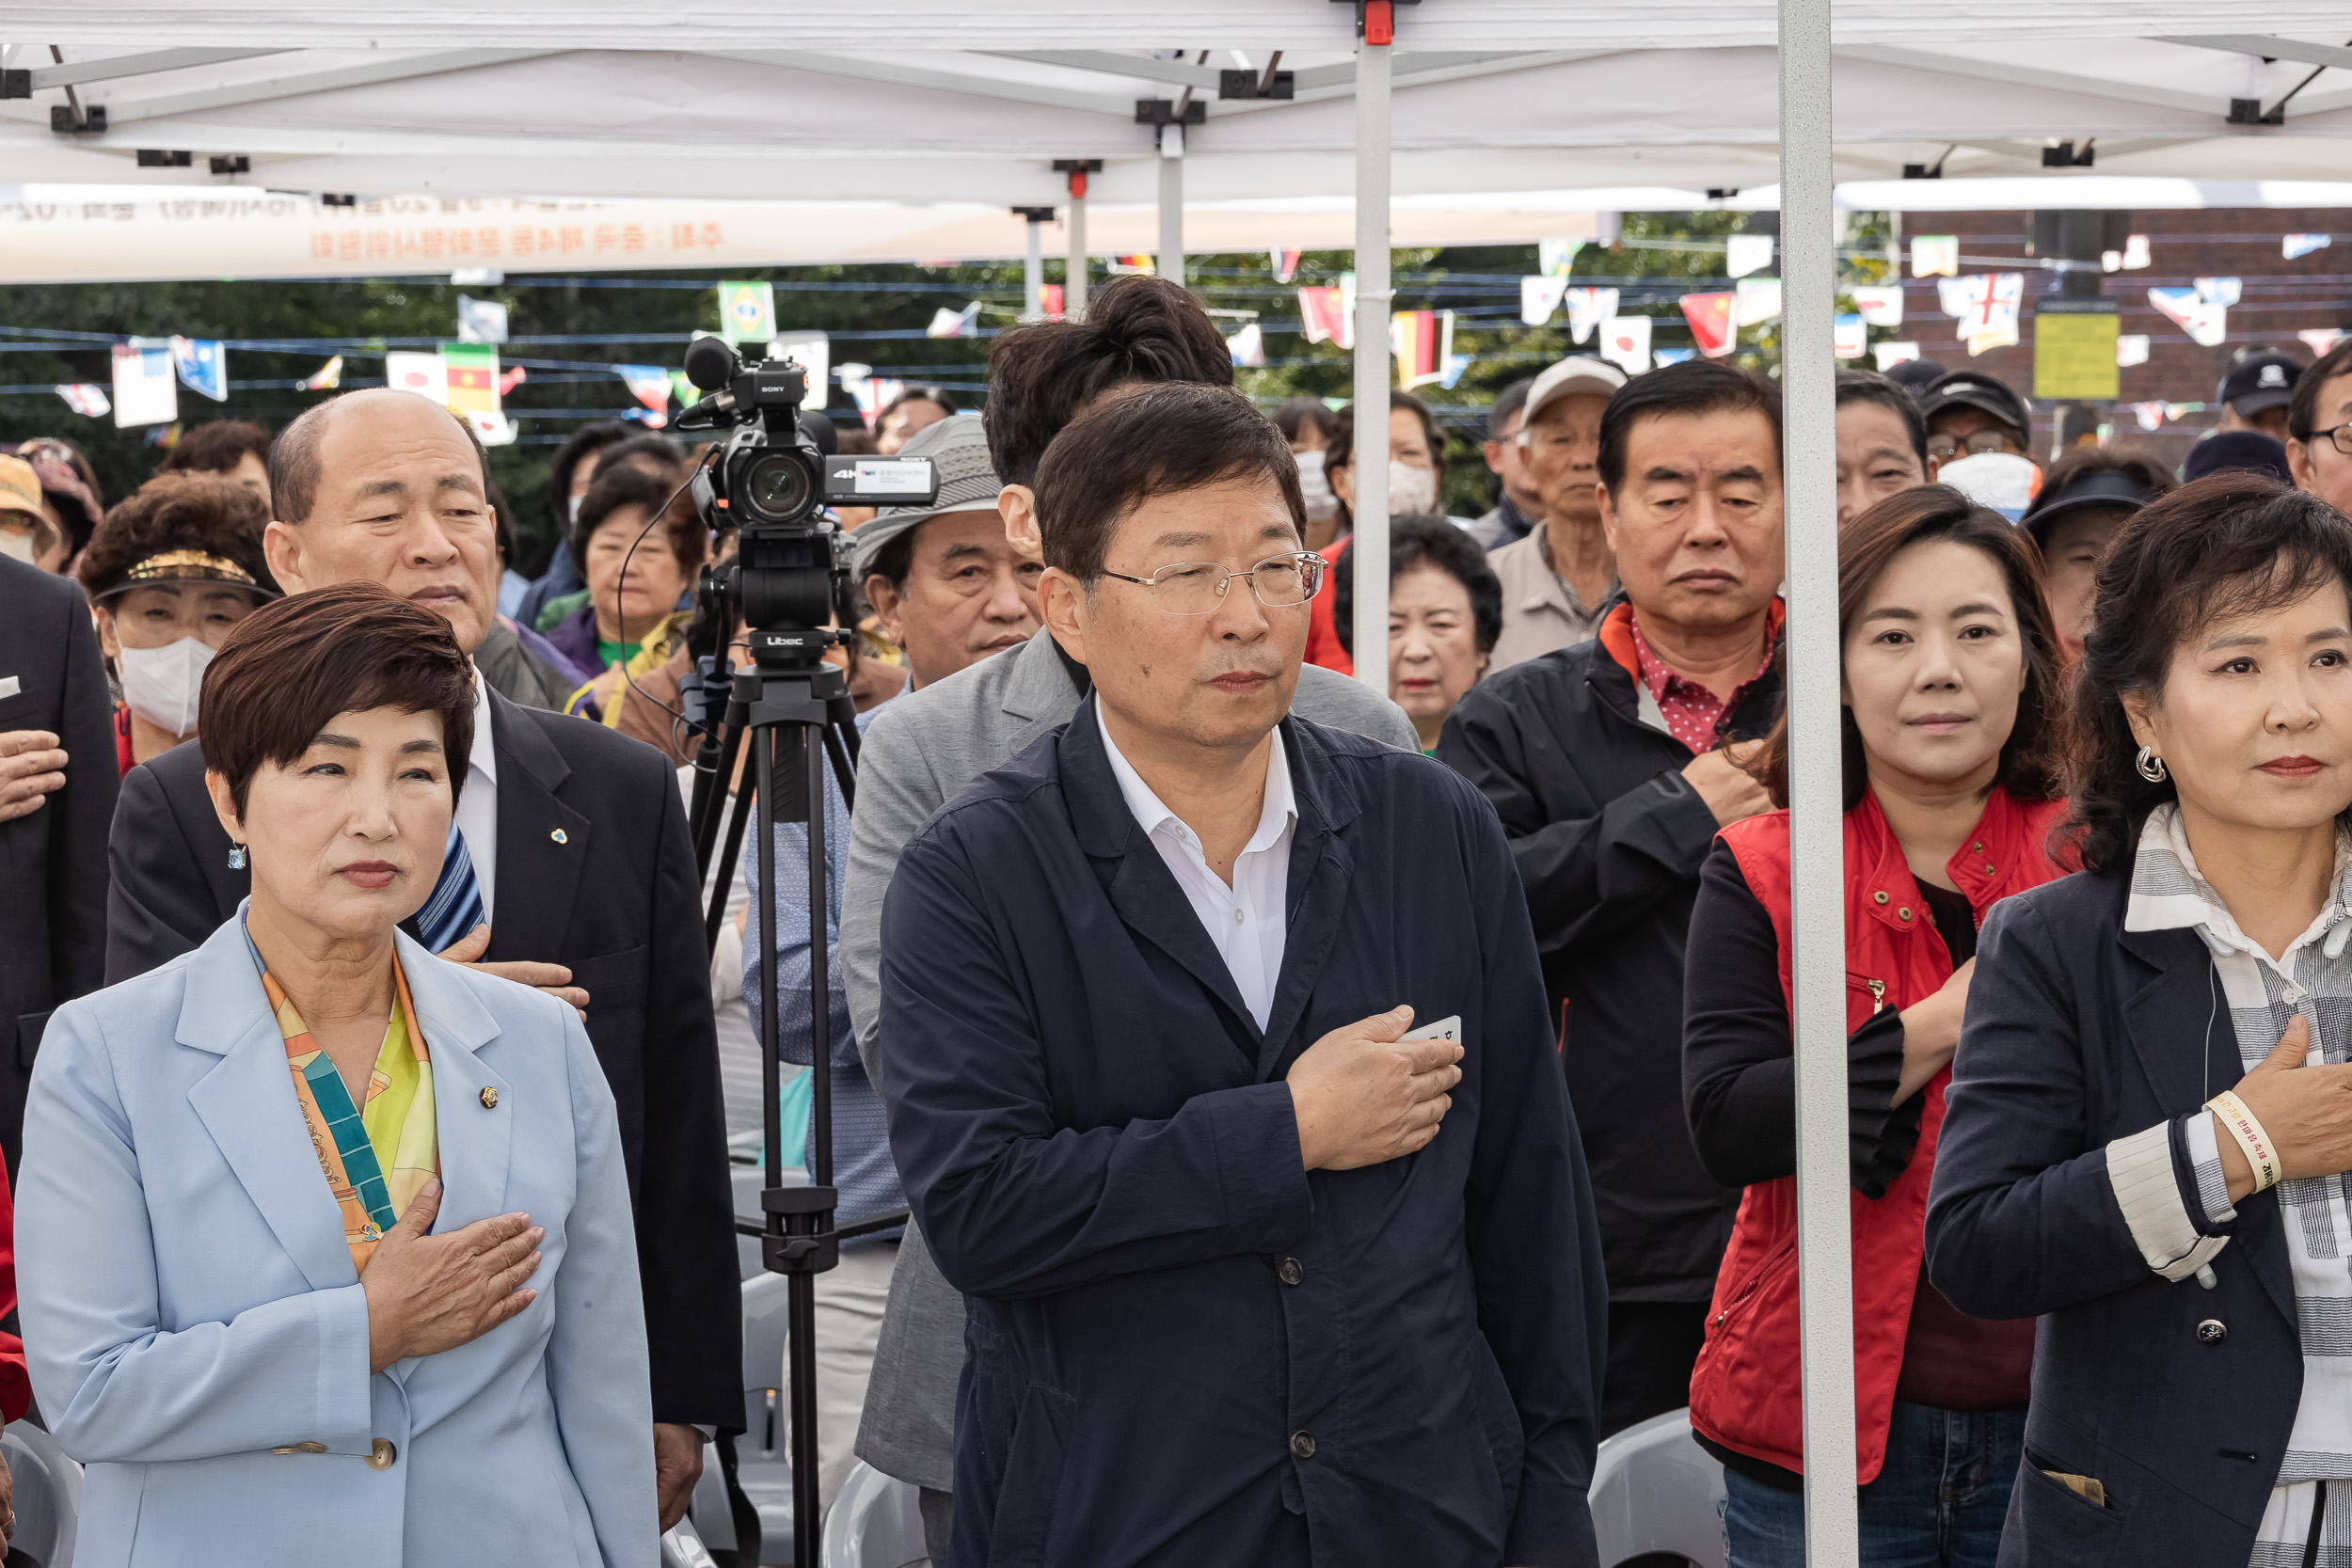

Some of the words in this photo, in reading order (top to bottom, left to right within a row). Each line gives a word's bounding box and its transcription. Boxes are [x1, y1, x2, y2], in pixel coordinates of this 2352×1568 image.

[767, 636, 804, 646] Libec
[2237, 1119, 2258, 1143] 한마음
[2254, 1143, 2267, 1161] 축제
